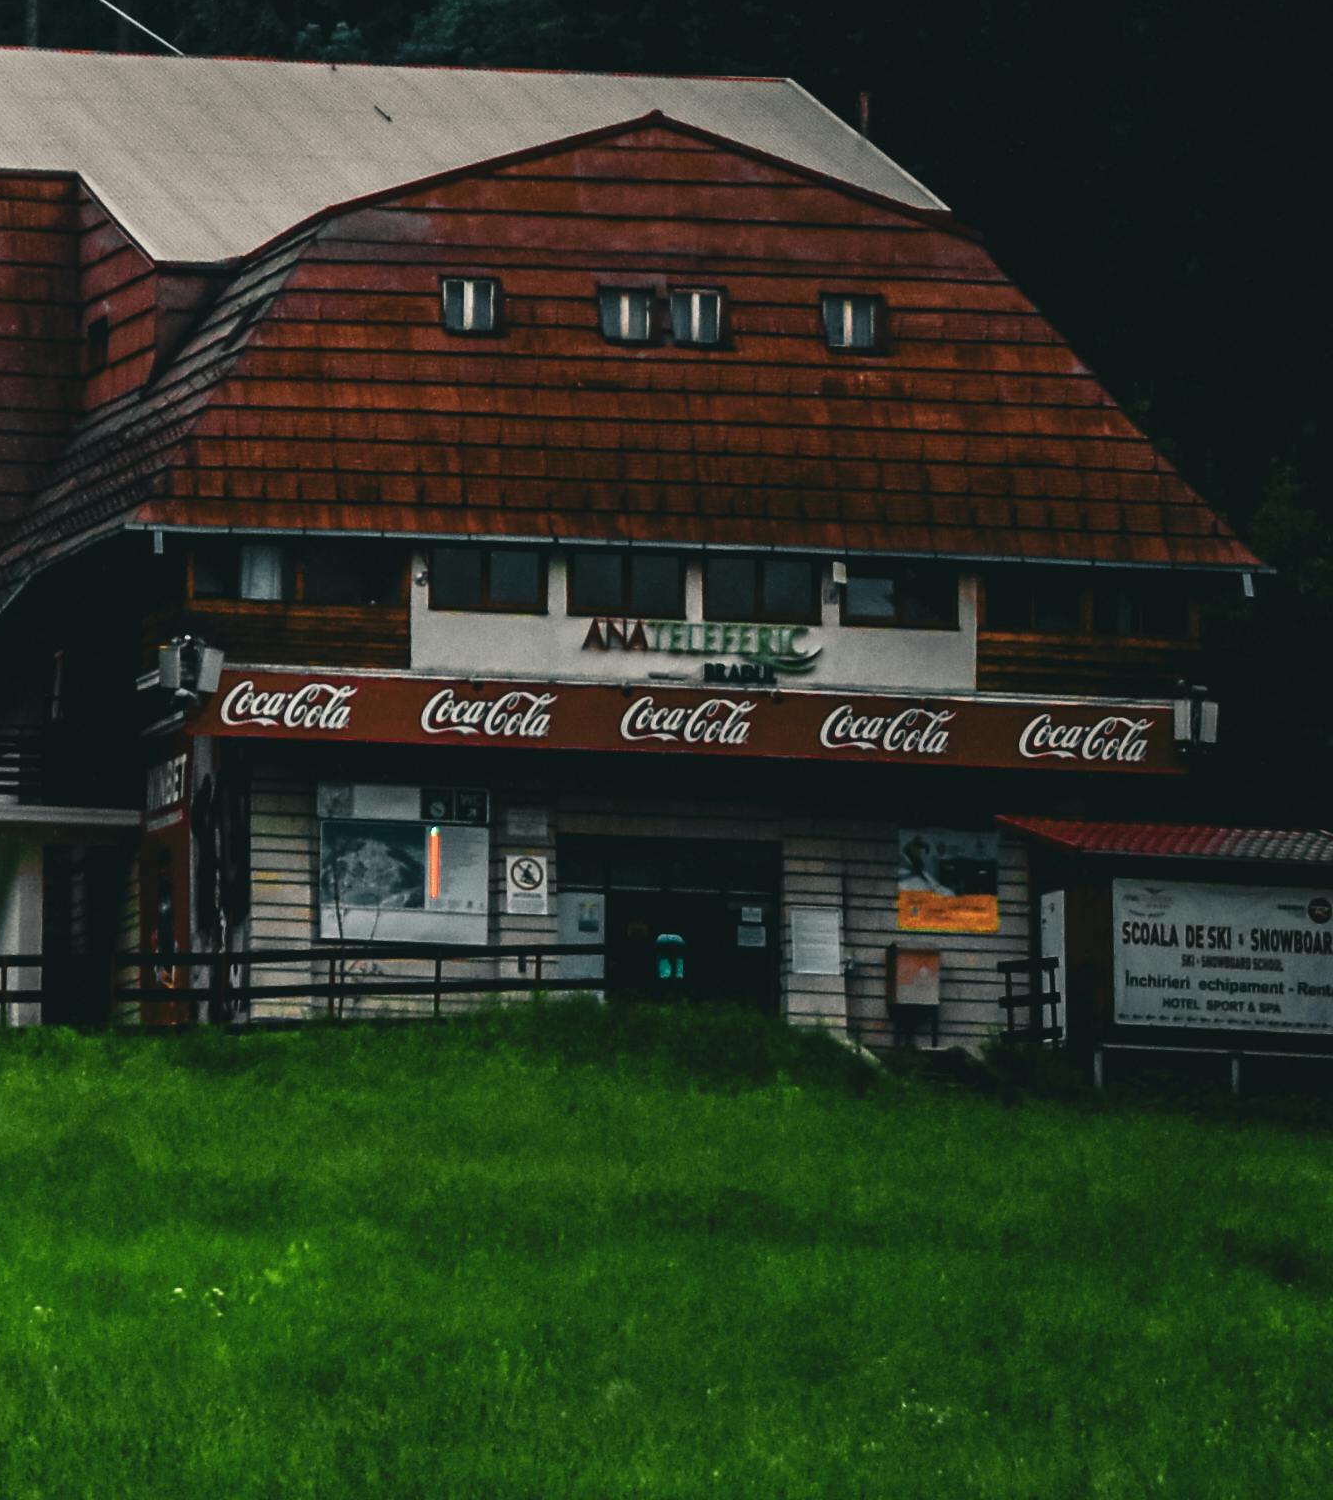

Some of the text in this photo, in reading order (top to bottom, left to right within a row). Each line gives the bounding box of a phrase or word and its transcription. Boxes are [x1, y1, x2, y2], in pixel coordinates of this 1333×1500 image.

[220, 680, 358, 729] Coca-Cola
[420, 688, 558, 737] Coca-Cola
[620, 696, 757, 745] Coca-Cola
[819, 704, 957, 754] Coca-Cola
[1018, 713, 1155, 762] Coca-Cola
[1122, 921, 1179, 947] SCOALA
[1185, 924, 1204, 949] DE
[1207, 926, 1232, 950] SKI
[1162, 998, 1200, 1010] HOTEL
[1206, 1000, 1245, 1012] SPORT
[1259, 1002, 1282, 1014] SPA
[1199, 977, 1284, 995] echipament
